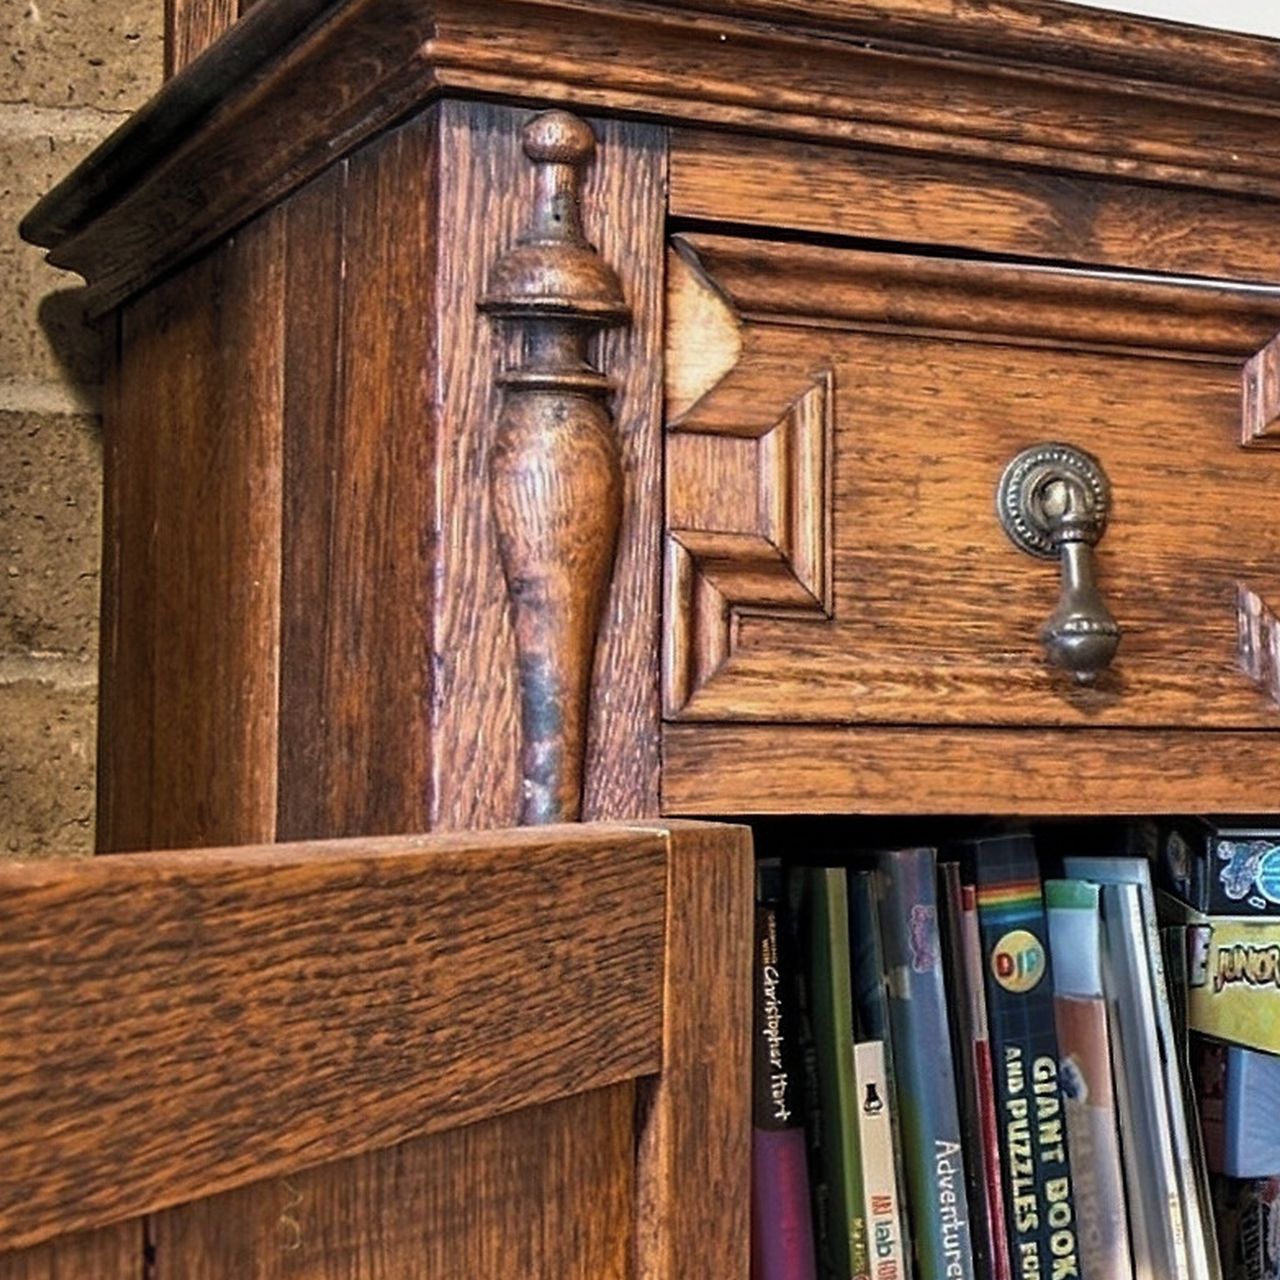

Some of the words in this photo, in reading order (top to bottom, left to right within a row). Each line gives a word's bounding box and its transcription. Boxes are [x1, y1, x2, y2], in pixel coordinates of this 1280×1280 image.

[760, 964, 785, 1070] Christopher
[771, 1073, 790, 1121] Hart
[1003, 1047, 1026, 1094] AND
[1032, 1054, 1064, 1165] GIANT
[1009, 1099, 1038, 1229] PUZZLES
[875, 1221, 896, 1257] lab
[1045, 1176, 1075, 1280] BOOK
